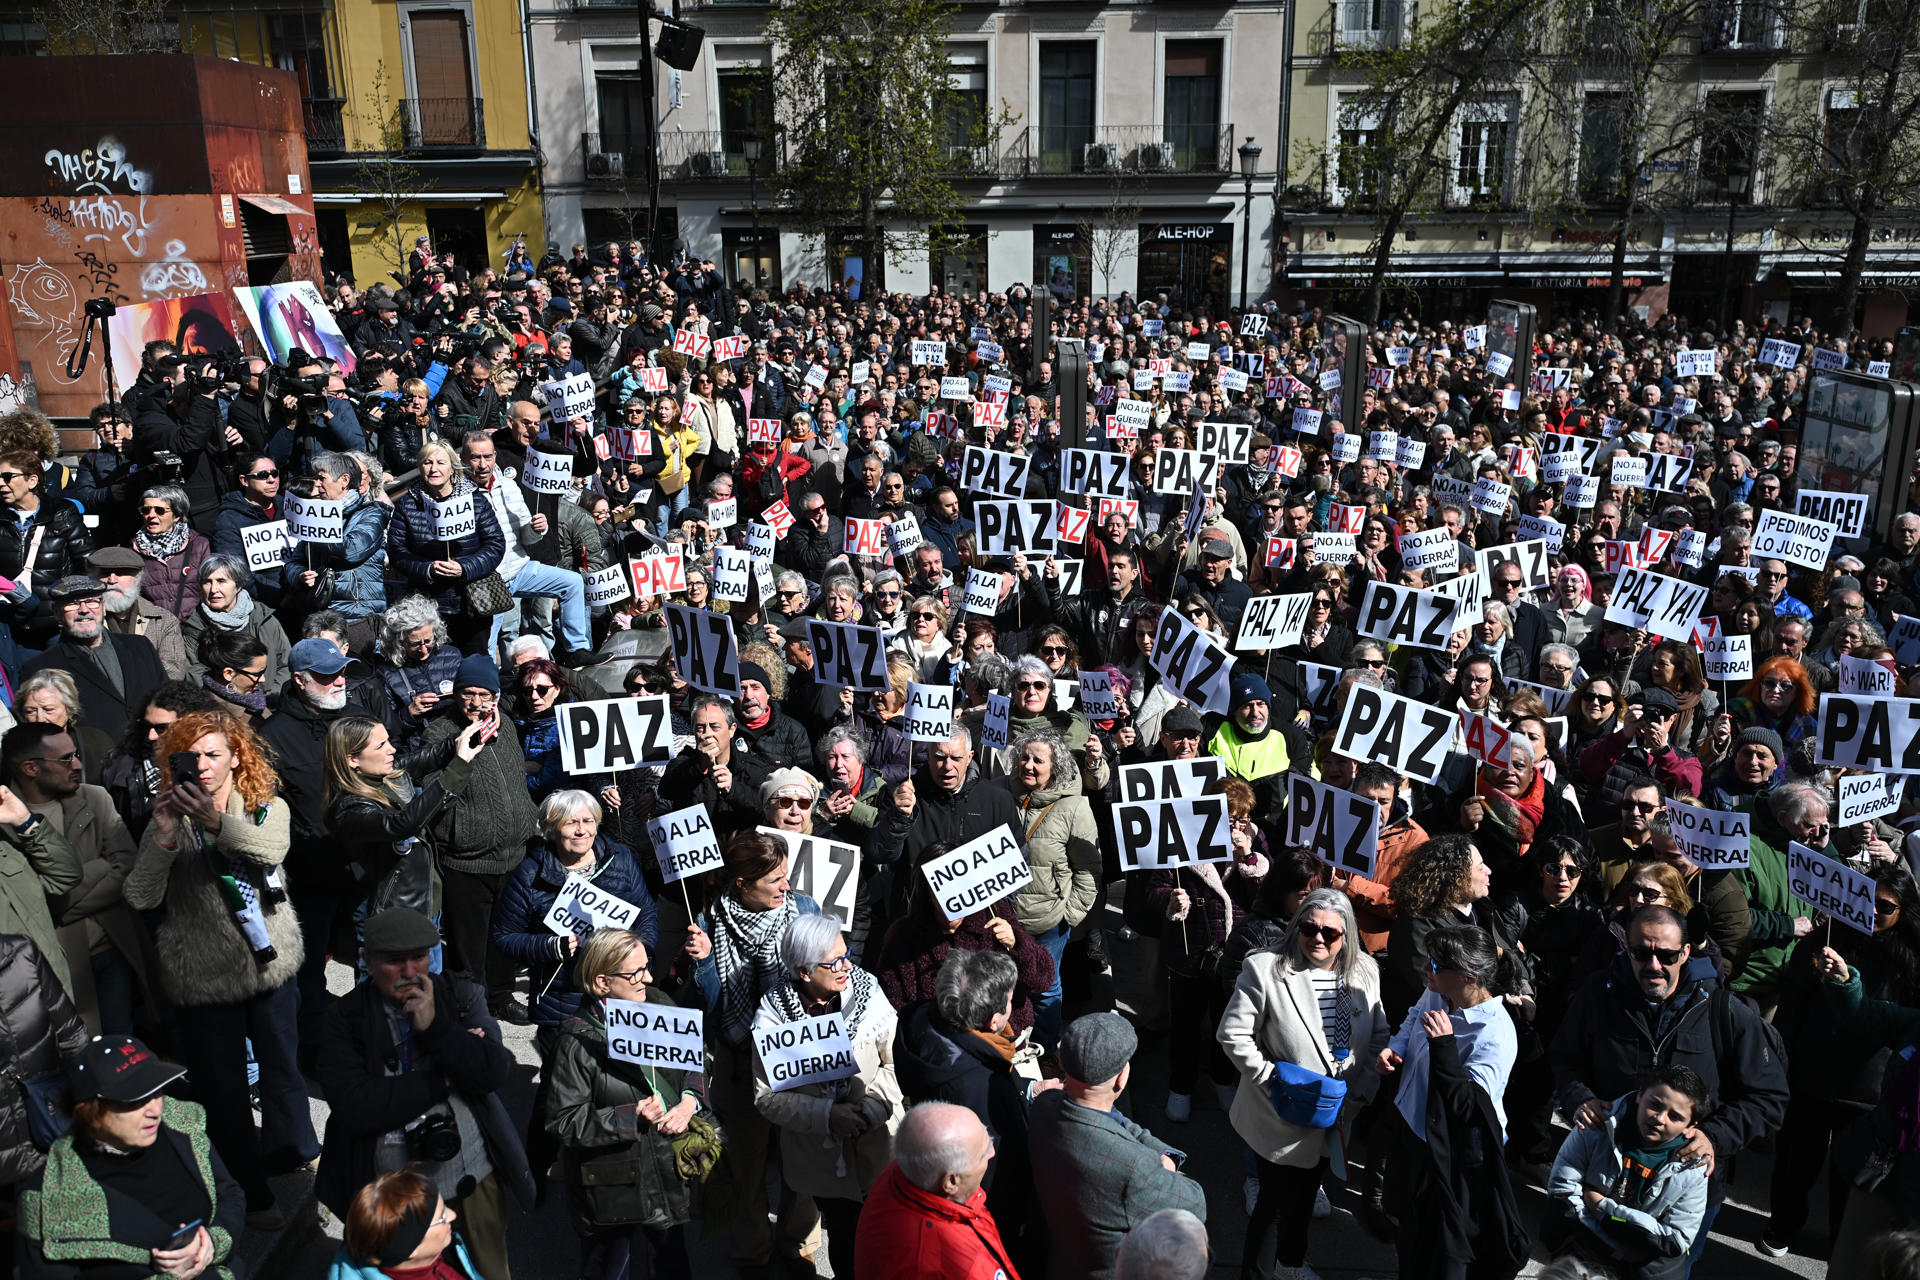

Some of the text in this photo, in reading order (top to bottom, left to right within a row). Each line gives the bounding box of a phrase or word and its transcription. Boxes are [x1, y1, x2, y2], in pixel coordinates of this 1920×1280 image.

[1158, 226, 1214, 239] ALE-HOP
[1243, 315, 1267, 334] PAZ
[675, 331, 710, 358] PAZ
[714, 336, 743, 360] PAZ
[915, 343, 943, 353] JUSTICIA
[1765, 339, 1796, 354] JUSTICIA
[915, 354, 943, 363] Y PAZ.
[1233, 354, 1263, 377] PAZ
[1680, 353, 1711, 363] JUSTICIA
[1775, 354, 1792, 365] PAZ.
[642, 368, 667, 391] PAZ
[1369, 369, 1392, 387] PAZ
[1680, 364, 1711, 374] Y PAZ.
[567, 383, 576, 394] A
[578, 380, 591, 391] LA
[1267, 377, 1294, 397] PAZ
[553, 398, 594, 418] GUERRA!
[975, 403, 1004, 426] PAZ
[1118, 402, 1150, 414] ¡NO A LA
[751, 420, 780, 442] PAZ
[927, 413, 958, 441] PAZ
[1116, 415, 1149, 427] GUERRA!
[1303, 415, 1320, 427] WAR!
[607, 428, 634, 460] PAZ
[1202, 427, 1249, 461] PAZ
[1352, 439, 1360, 447] LA
[541, 460, 570, 472] A LA
[1267, 447, 1300, 476] PAZ
[1543, 453, 1578, 465] ¡NO A LA
[1613, 461, 1630, 470] ¡NO
[524, 472, 571, 490] GUERRA!
[965, 450, 1027, 496] PAZ
[1070, 451, 1127, 497] PAZ
[1157, 450, 1217, 495] PAZ
[1547, 466, 1581, 478] GUERRA!
[1449, 484, 1470, 495] A LA
[1490, 483, 1507, 494] A LA
[1582, 480, 1589, 488] A
[284, 497, 340, 518] ¡NO A LA
[445, 502, 472, 518] A LA
[1473, 493, 1504, 510] GUERRA!
[711, 509, 720, 520] NO
[764, 502, 796, 539] PAZ
[1328, 502, 1365, 533] PAZ
[287, 520, 342, 540] GUERRA!
[749, 526, 770, 539] A LA
[845, 519, 881, 553] PAZ
[895, 521, 914, 535] A LA
[979, 502, 1053, 552] PAZ
[1520, 519, 1562, 537] ¡NO A LA
[1762, 514, 1830, 542] ¡PEDIMOS
[244, 530, 272, 547] ¡NO
[1314, 538, 1355, 548] ¡NO A LA
[1401, 533, 1449, 552] ¡NO A LA
[1688, 536, 1695, 544] A
[1405, 550, 1453, 569] GUERRA!
[1755, 537, 1825, 565] LO JUSTO!
[598, 569, 619, 582] A LA
[715, 558, 746, 572] A LA
[632, 556, 686, 597] PAZ
[970, 574, 996, 588] A LA
[585, 583, 625, 602] GUERRA!
[1612, 570, 1706, 627] PAZ, YA!
[1242, 594, 1311, 643] PAZ, YA!
[1364, 585, 1457, 648] PAZ
[668, 606, 736, 691] PAZ
[810, 623, 885, 687] PAZ
[1718, 640, 1746, 651] A LA
[1154, 611, 1227, 706] PAZ
[1082, 678, 1110, 691] A LA
[1858, 670, 1890, 691] WAR!
[912, 694, 949, 710] A LA
[993, 704, 1006, 720] LA
[569, 699, 670, 770] PAZ
[1340, 688, 1451, 779] PAZ
[1126, 760, 1219, 801] PAZ
[1841, 780, 1863, 799] ¡NO
[1866, 775, 1881, 789] A
[1844, 793, 1900, 819] GUERRA!
[670, 814, 709, 841] A LA
[1119, 799, 1228, 865] PAZ
[1291, 778, 1374, 873] PAZ
[1668, 808, 1747, 838] ¡NO A LA
[1675, 836, 1748, 864] GUERRA!
[931, 836, 1016, 892] ¡NO A LA
[945, 861, 1030, 913] GUERRA!
[1790, 852, 1872, 904] ¡NO A LA
[562, 882, 630, 924] ¡NO A LA
[1792, 879, 1873, 931] GUERRA!
[609, 1009, 700, 1037] ¡NO A LA
[761, 1020, 840, 1056] ¡NO A LA
[612, 1039, 703, 1066] GUERRA!
[773, 1050, 852, 1082] GUERRA!
